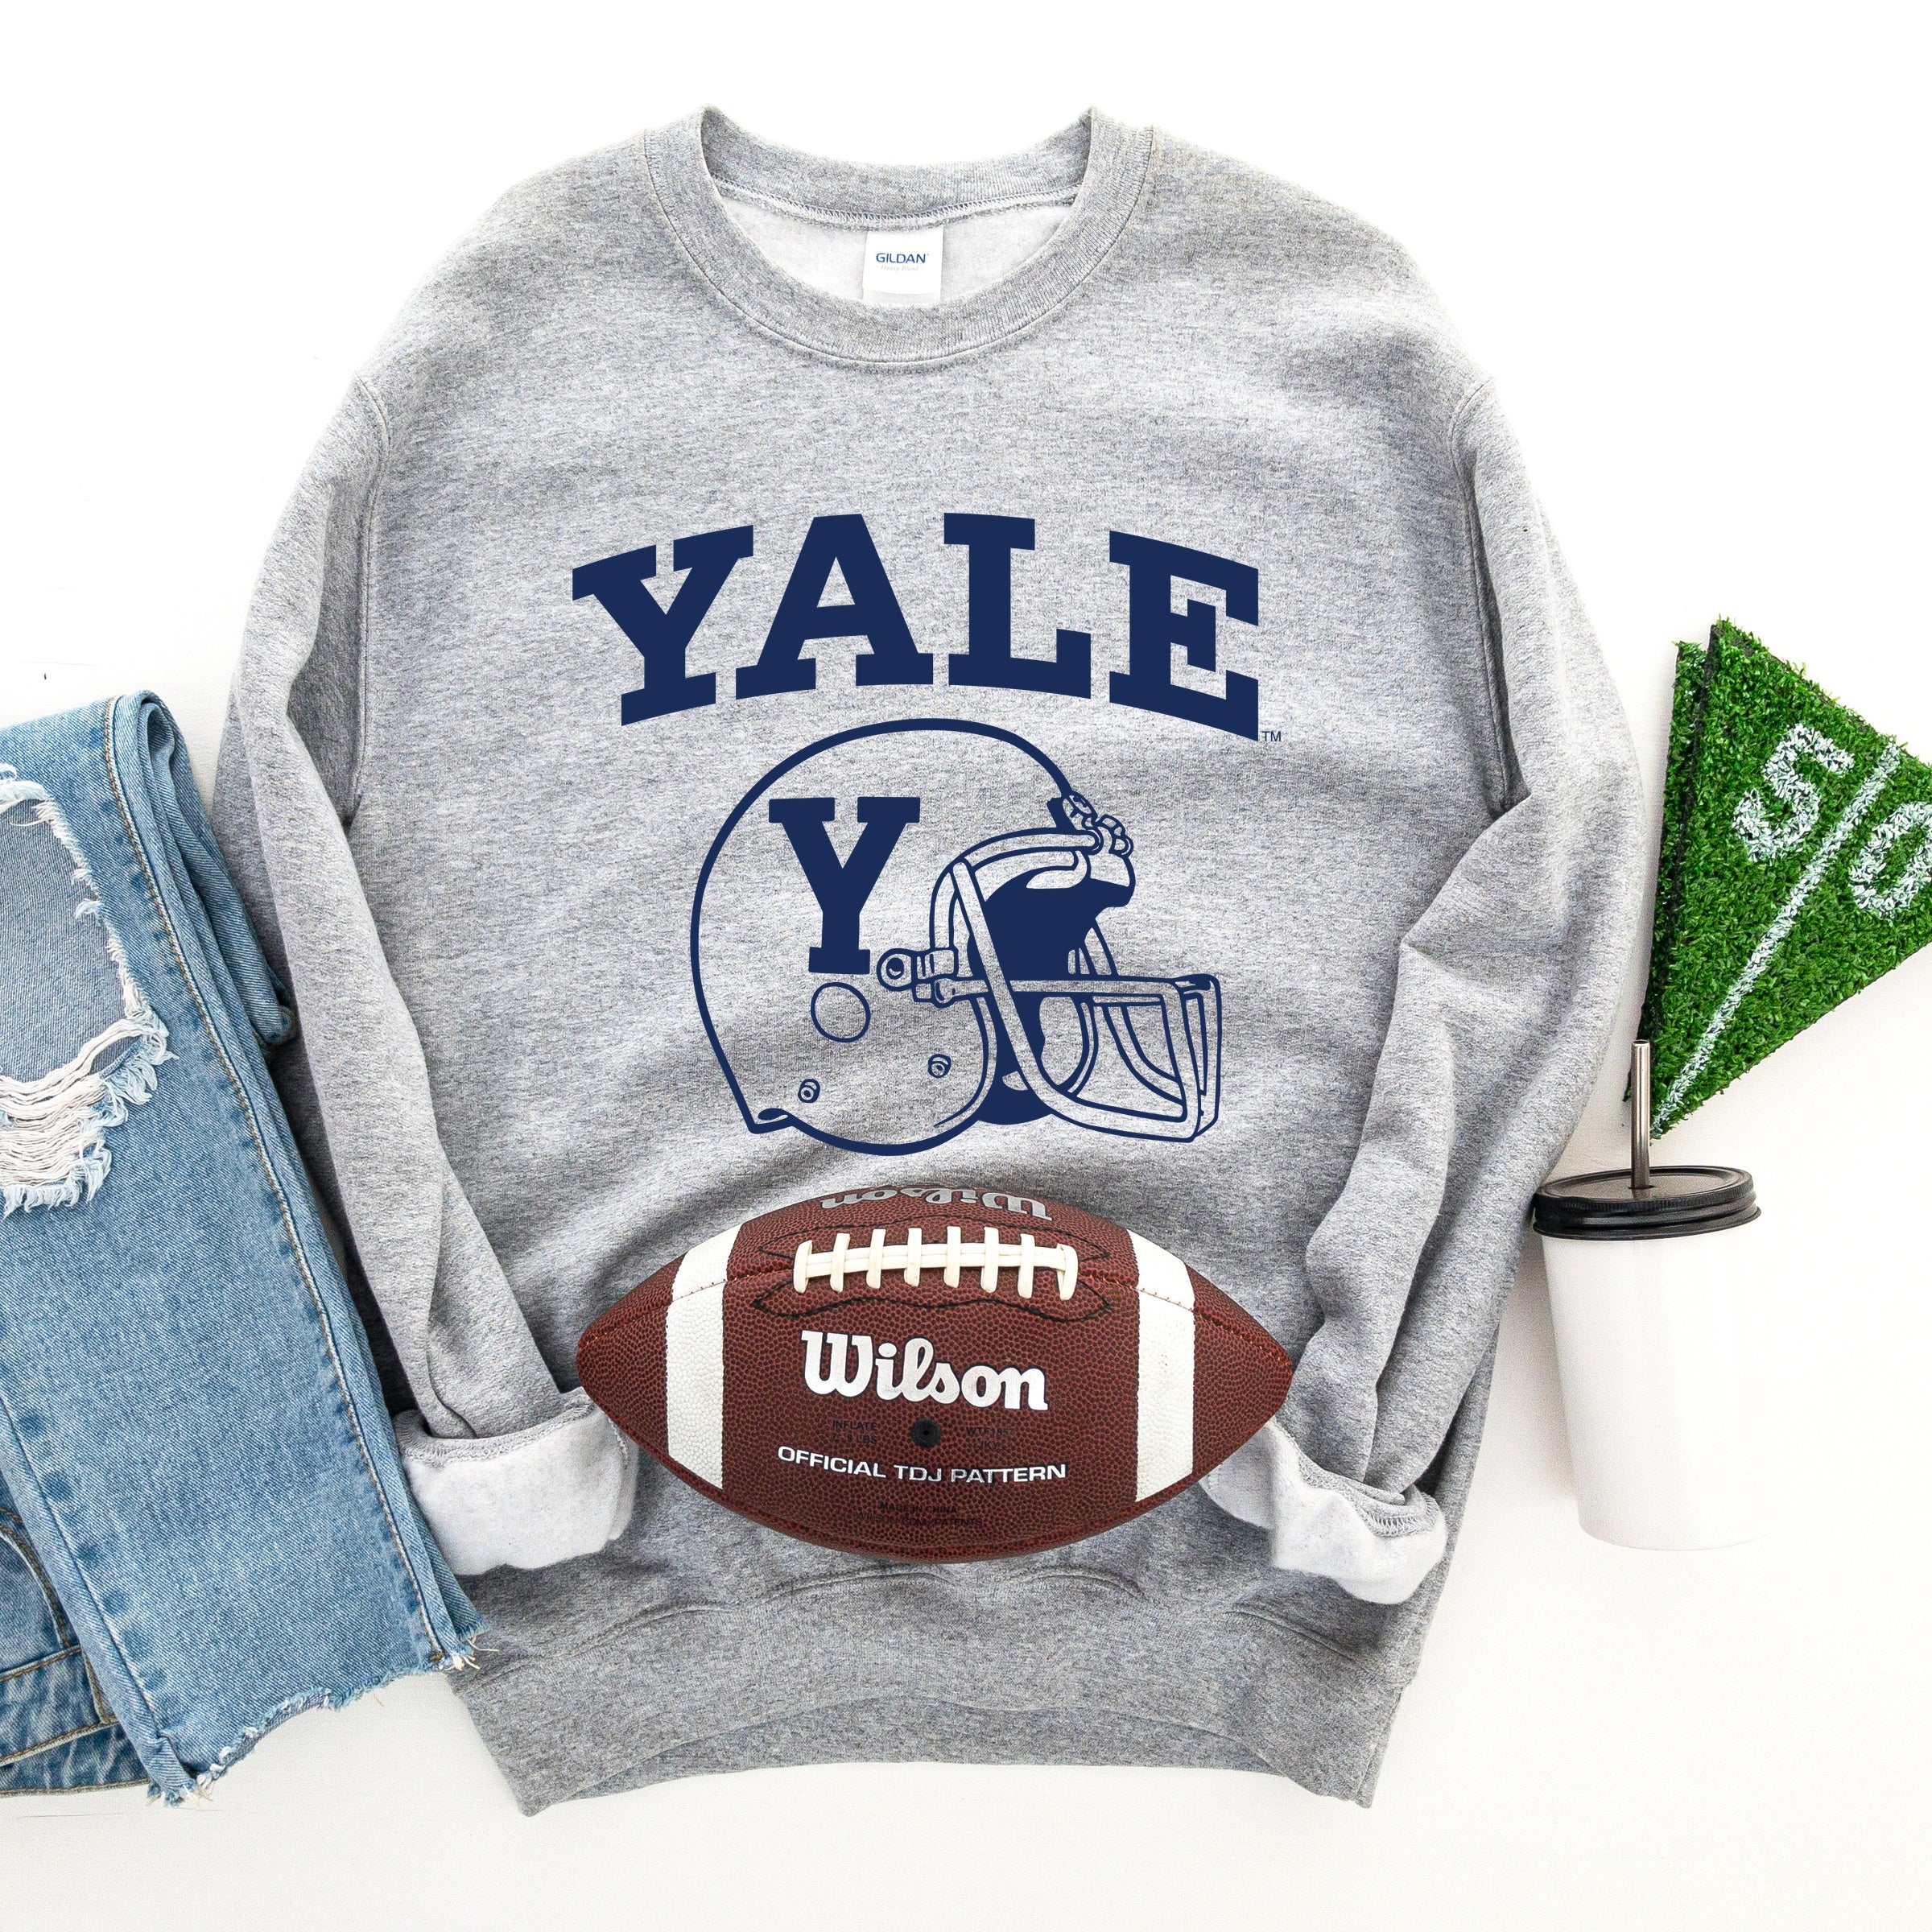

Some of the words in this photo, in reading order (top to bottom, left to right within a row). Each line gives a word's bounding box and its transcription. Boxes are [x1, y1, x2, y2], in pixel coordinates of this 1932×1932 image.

[876, 253, 926, 264] GILDAN
[572, 513, 1259, 741] YALE
[1261, 731, 1282, 741] TM
[769, 796, 921, 975] Y
[819, 1187, 1053, 1221] Wilson
[800, 1330, 1049, 1410] Wilson
[832, 1419, 877, 1431] INFLATE
[778, 1446, 886, 1478] OFFICIAL
[894, 1464, 942, 1482] TDJ
[951, 1463, 1066, 1484] PATTERN
[926, 1505, 957, 1513] CHINA
